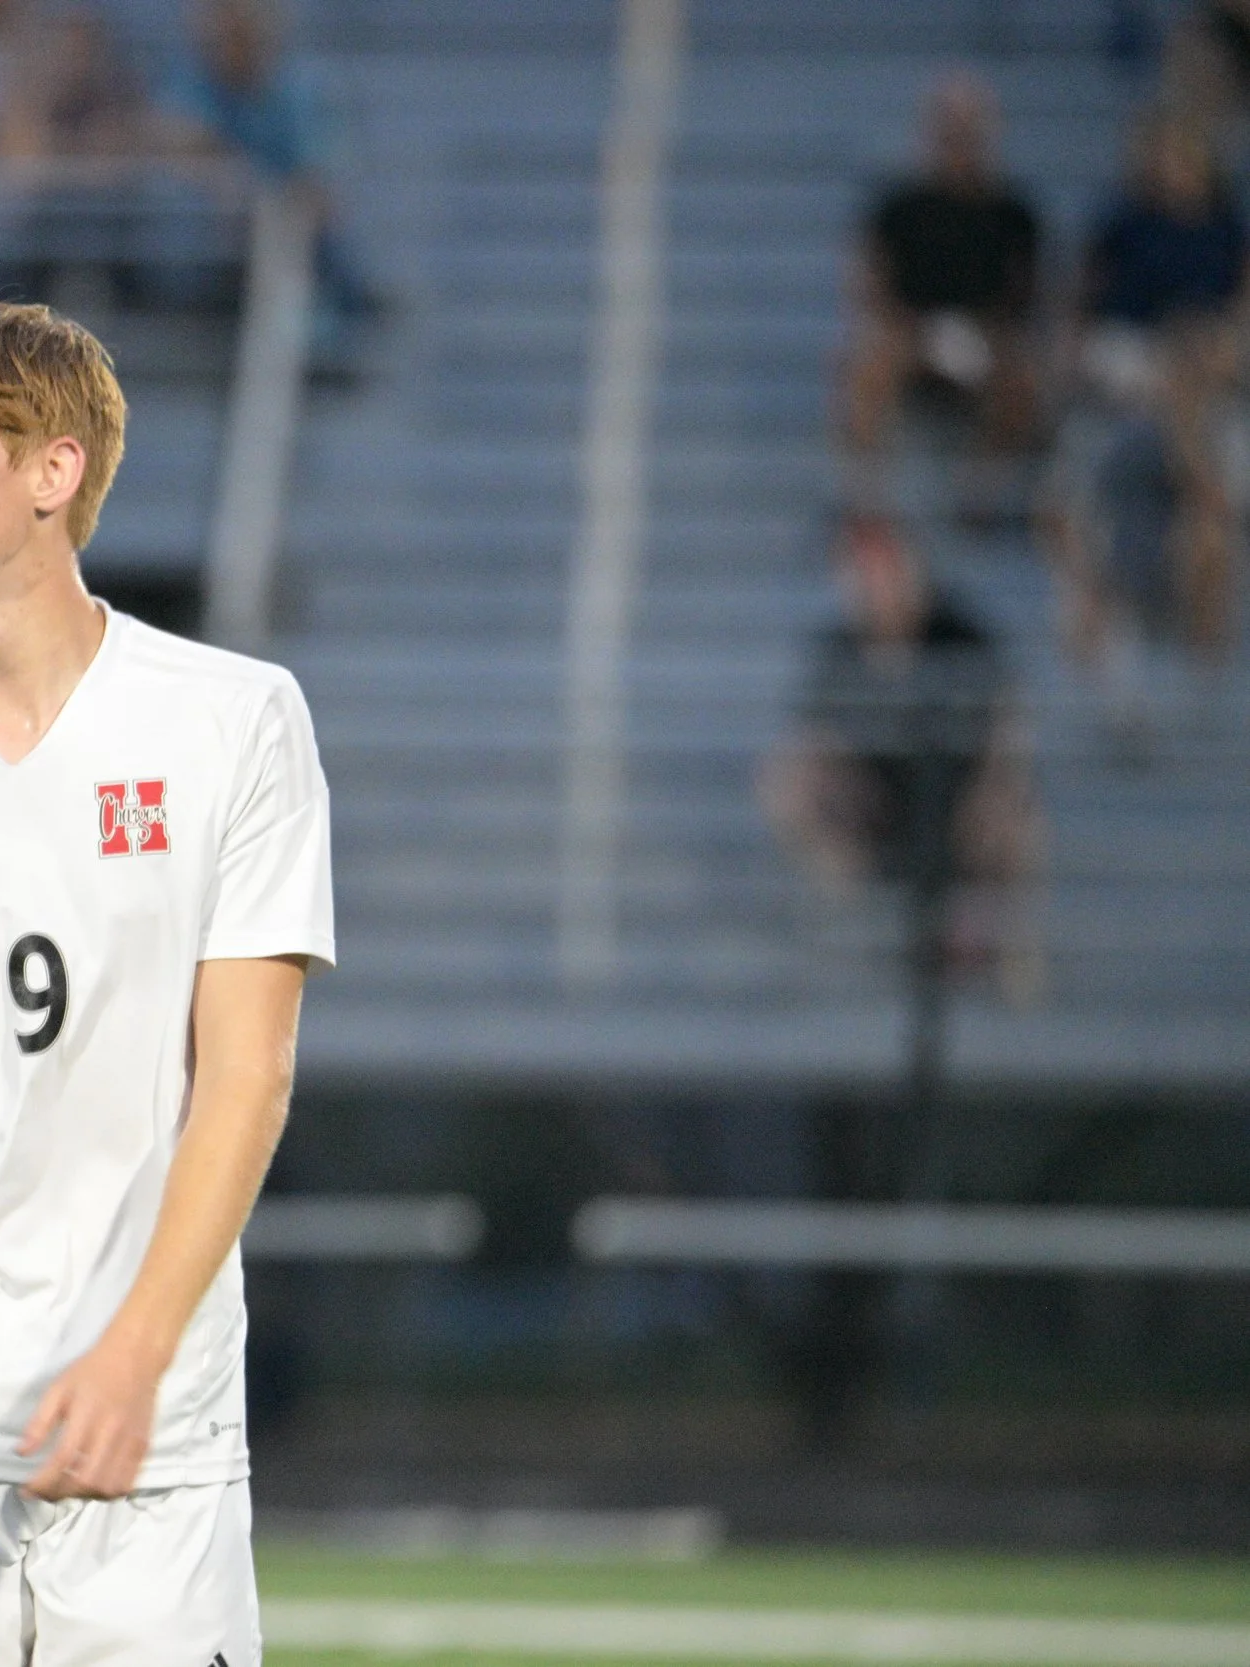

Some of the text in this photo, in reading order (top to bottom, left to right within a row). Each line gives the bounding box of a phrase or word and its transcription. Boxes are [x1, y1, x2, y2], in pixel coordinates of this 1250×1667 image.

[95, 778, 170, 859] H
[99, 794, 167, 842] Chargers
[7, 931, 69, 1056] 9
